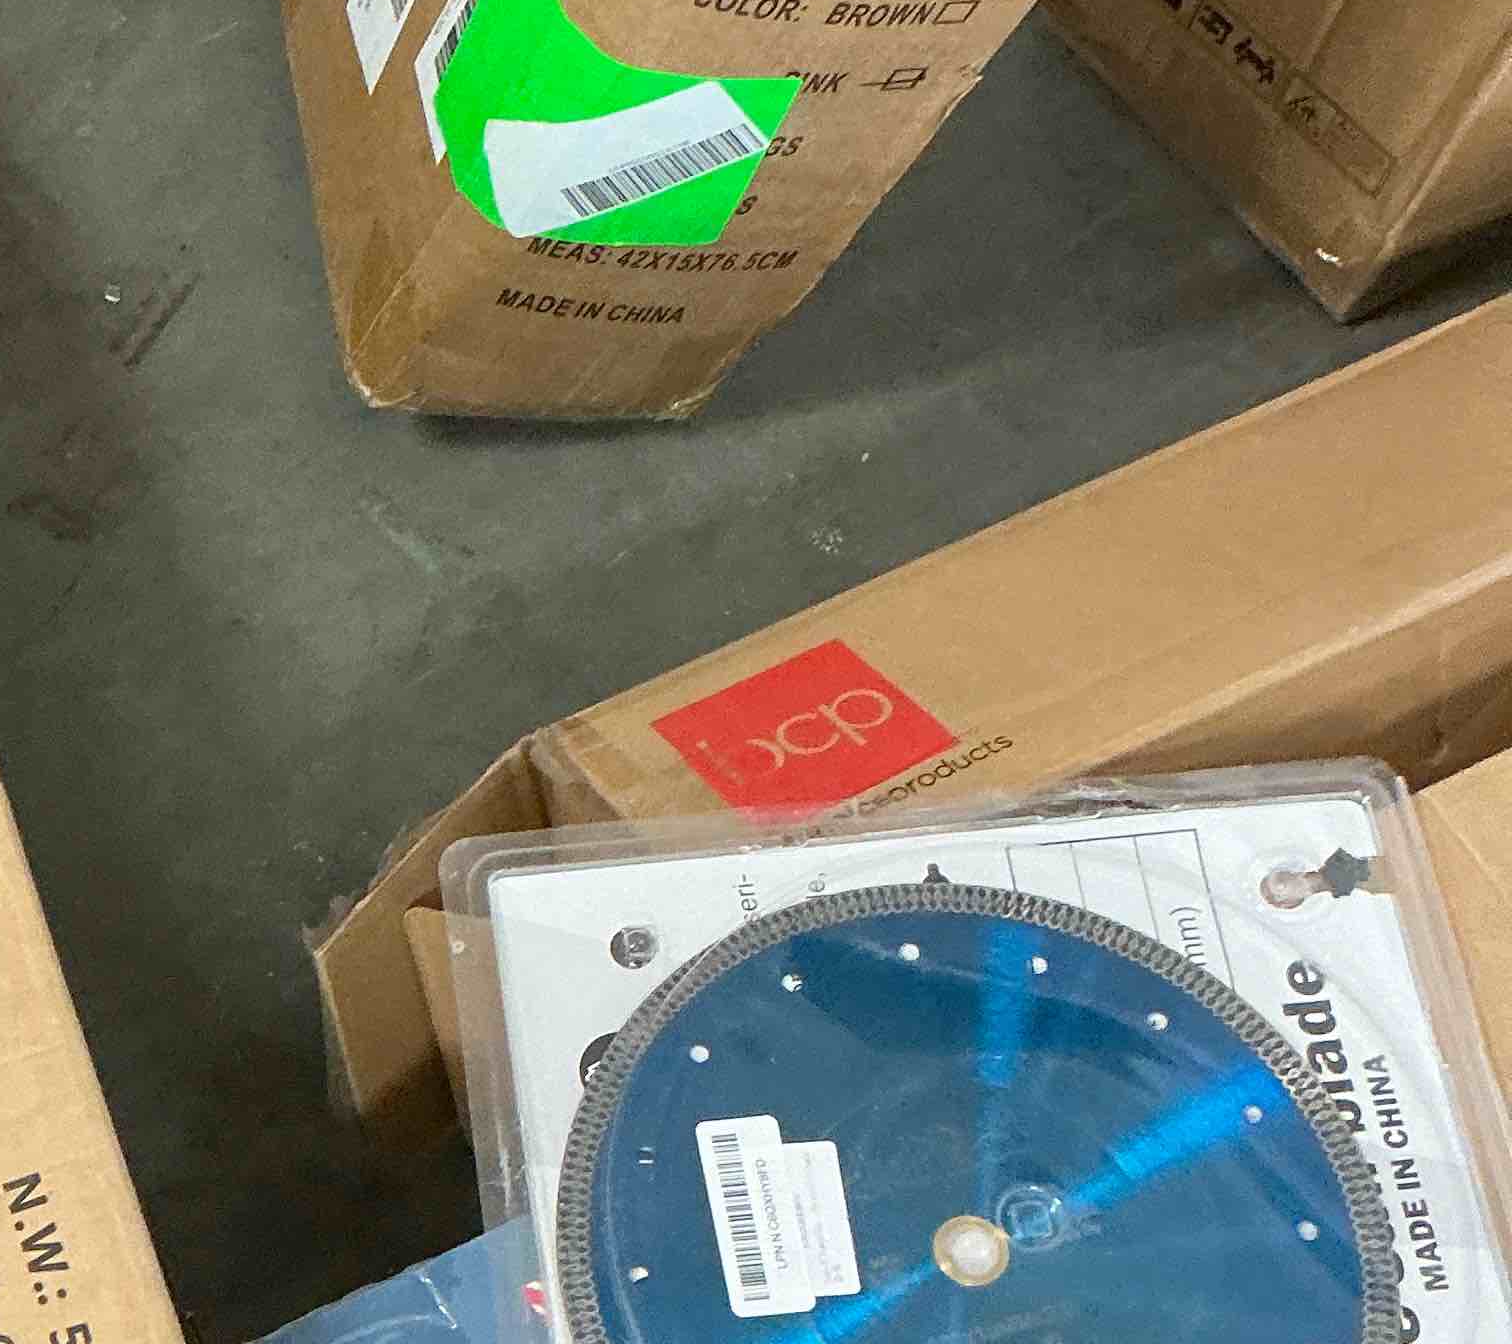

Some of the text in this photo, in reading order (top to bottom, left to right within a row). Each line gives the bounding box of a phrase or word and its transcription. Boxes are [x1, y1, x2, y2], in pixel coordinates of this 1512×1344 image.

[783, 67, 849, 97] INK
[495, 287, 686, 325] MADE IN CHINA
[1361, 1053, 1409, 1150] CHINA
[1393, 1158, 1421, 1192] IN
[1, 1170, 70, 1307] N.W.:
[1401, 1197, 1450, 1293] MADE
